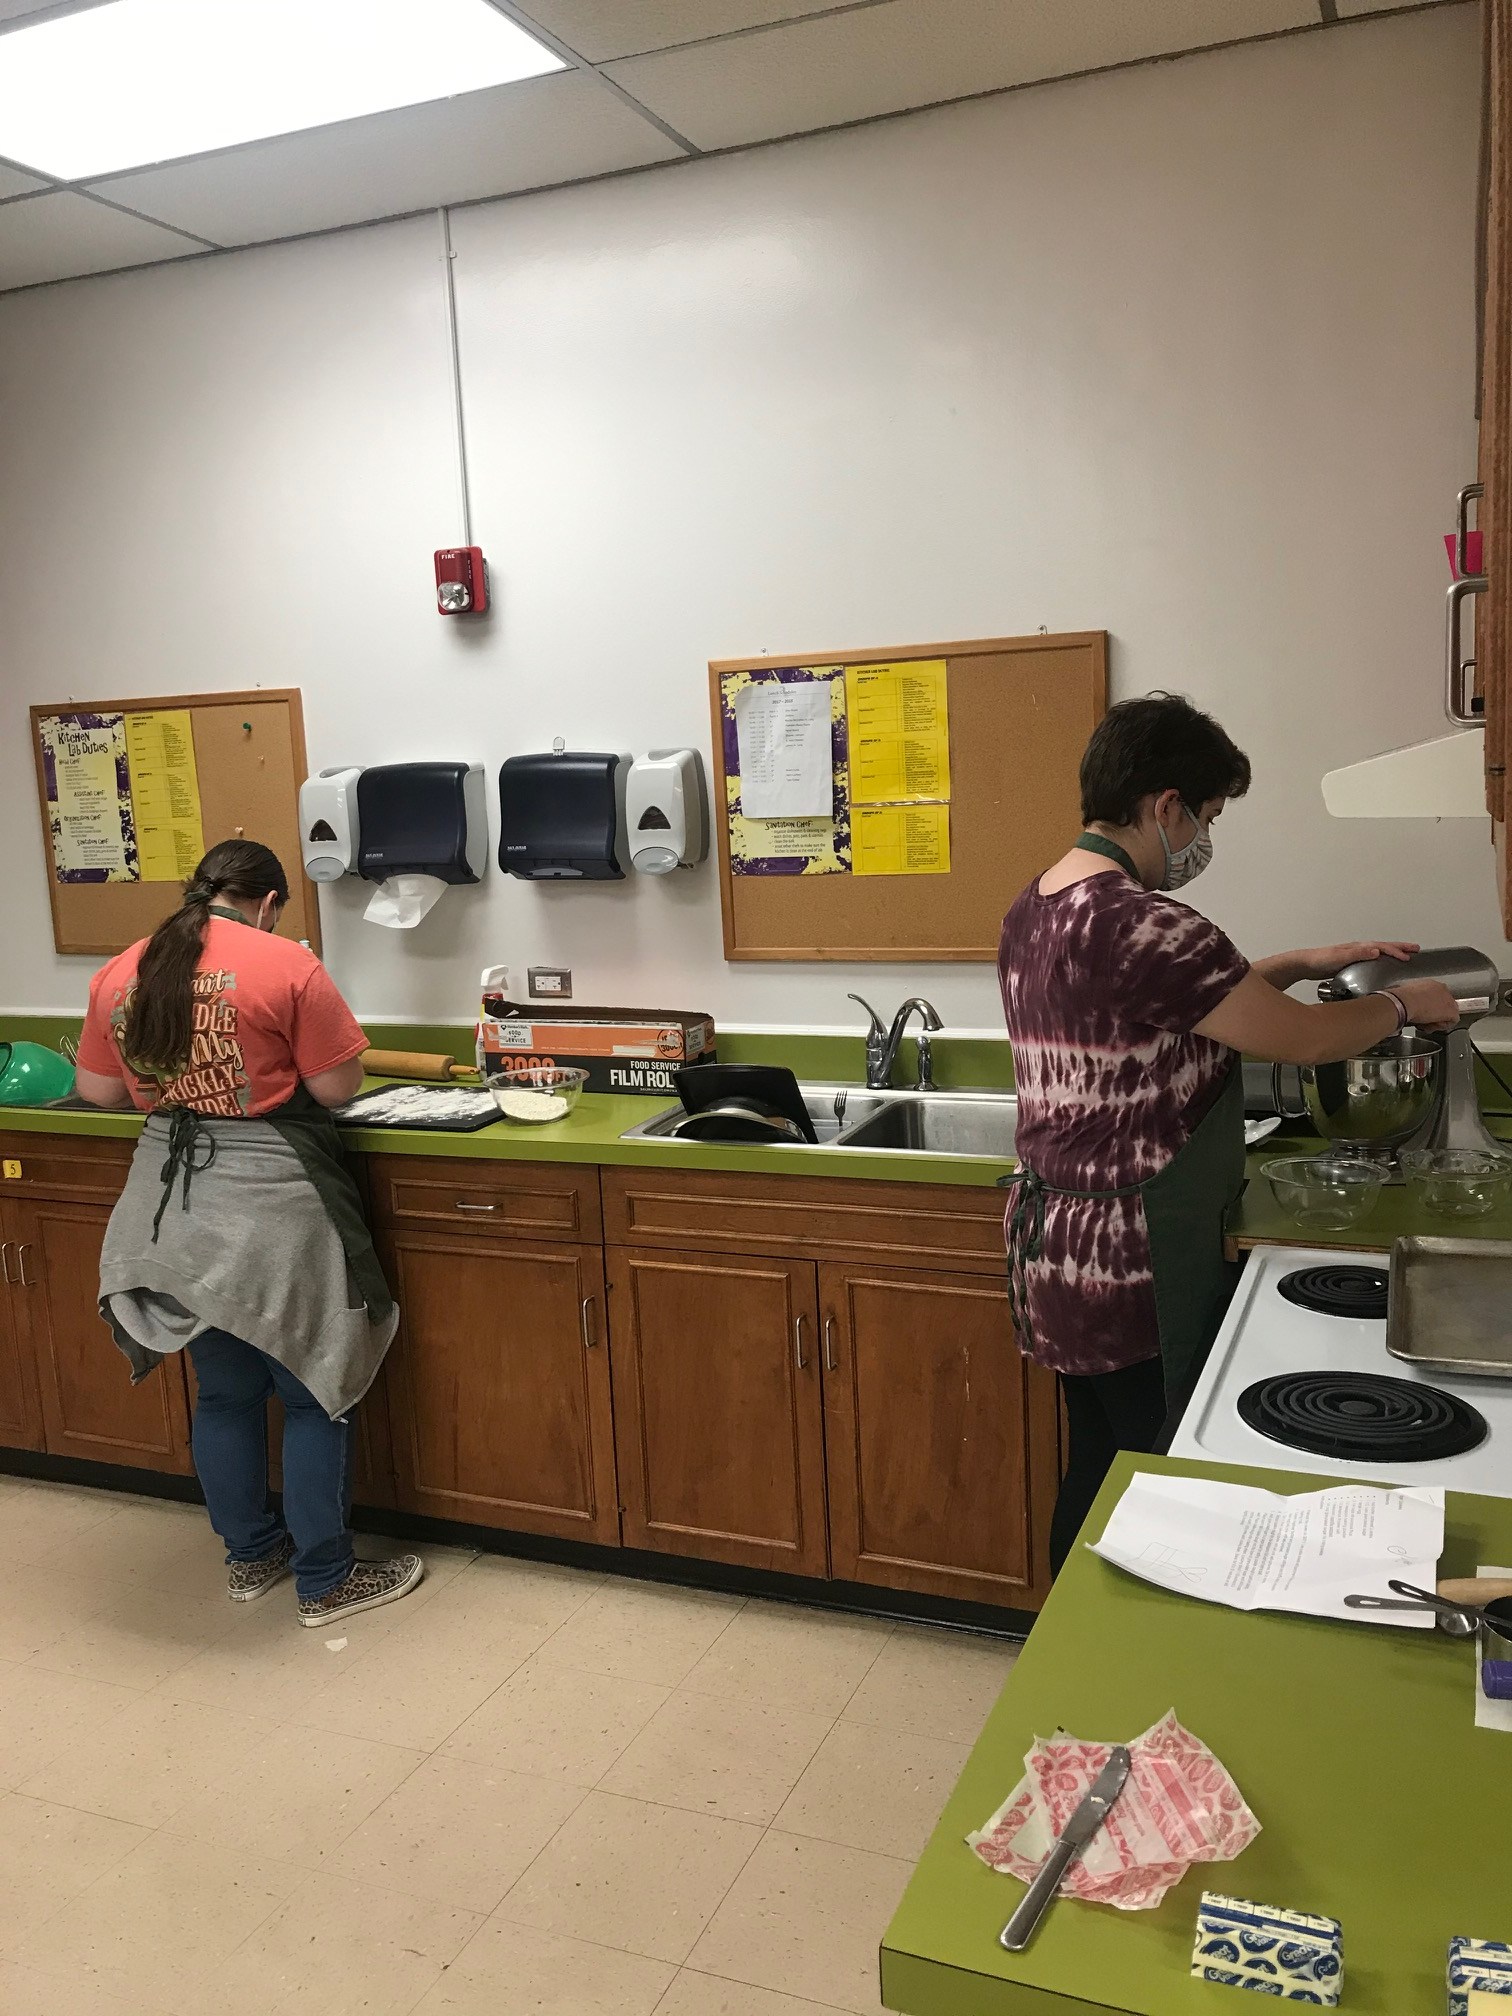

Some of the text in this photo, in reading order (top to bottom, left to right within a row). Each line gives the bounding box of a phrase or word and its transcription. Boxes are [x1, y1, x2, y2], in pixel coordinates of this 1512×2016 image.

[68, 743, 81, 757] Lab
[191, 1030, 244, 1070] My
[630, 1060, 681, 1071] FOOD SERVICE
[610, 1069, 675, 1089] FILM ROL
[10, 1163, 17, 1175] 5
